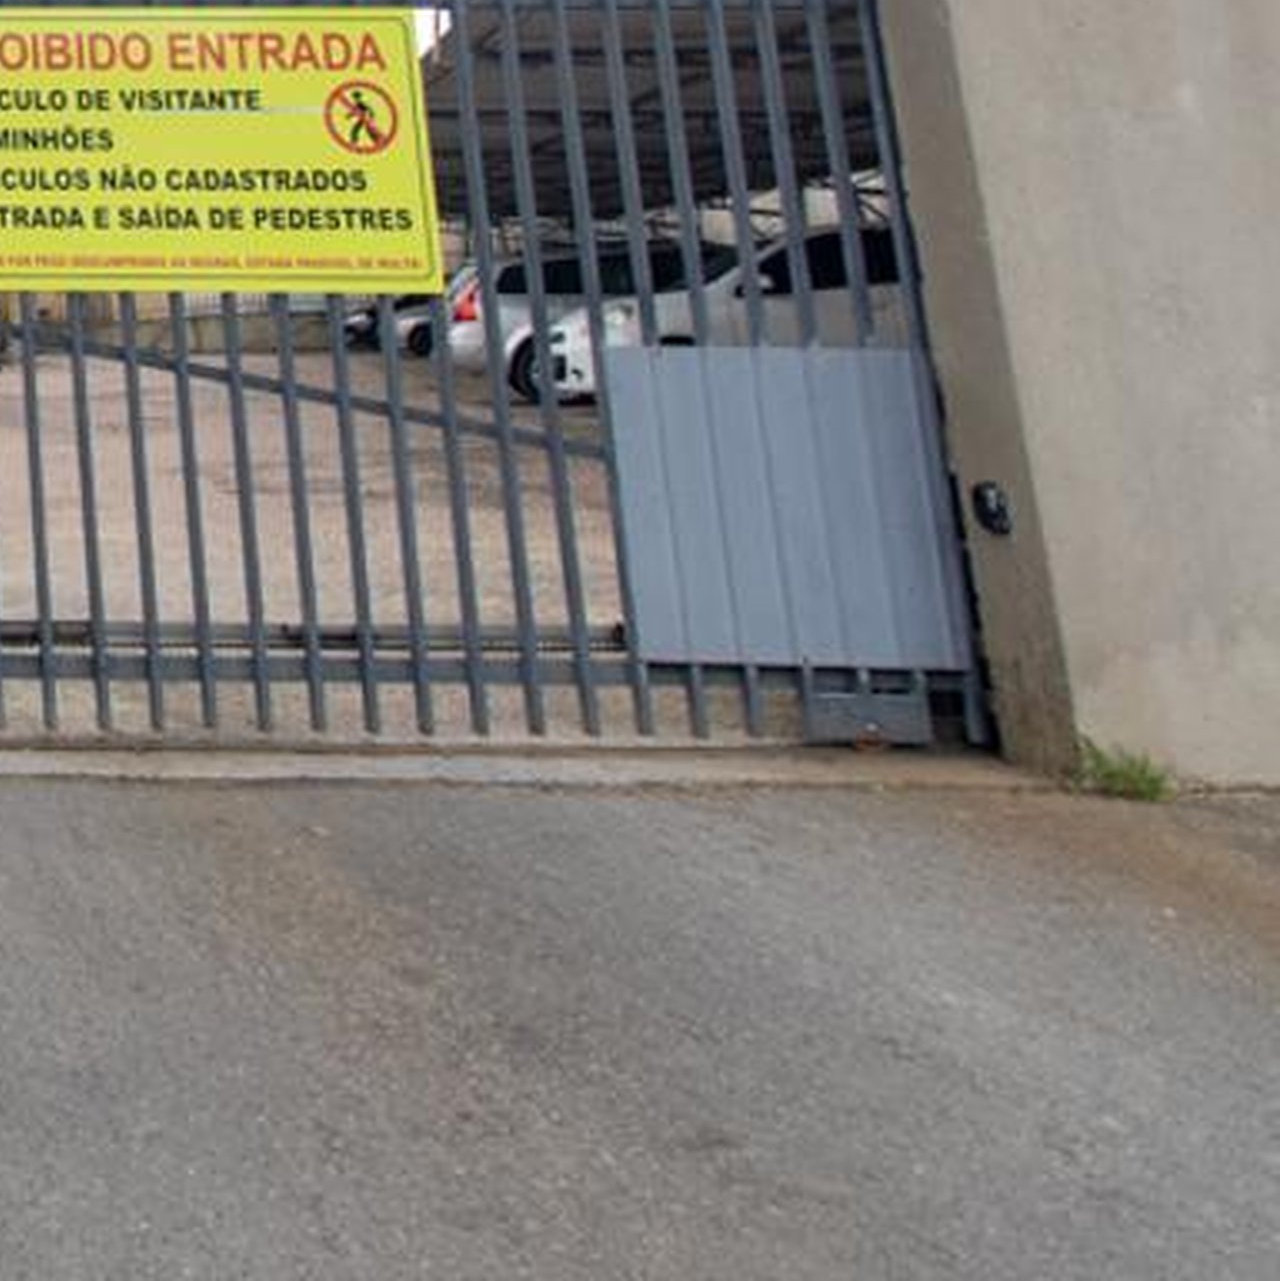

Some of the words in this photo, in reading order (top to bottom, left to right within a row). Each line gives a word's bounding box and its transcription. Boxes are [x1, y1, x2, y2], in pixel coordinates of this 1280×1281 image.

[168, 33, 386, 71] ENTRADA
[76, 89, 110, 111] DE
[120, 88, 261, 112] VISITANTE
[99, 163, 158, 191] NÃO
[164, 169, 367, 192] CADASTRADOS
[93, 207, 109, 229] E
[118, 202, 201, 230] SAÍDA
[208, 209, 244, 230] DE
[253, 208, 414, 231] PEDESTRES
